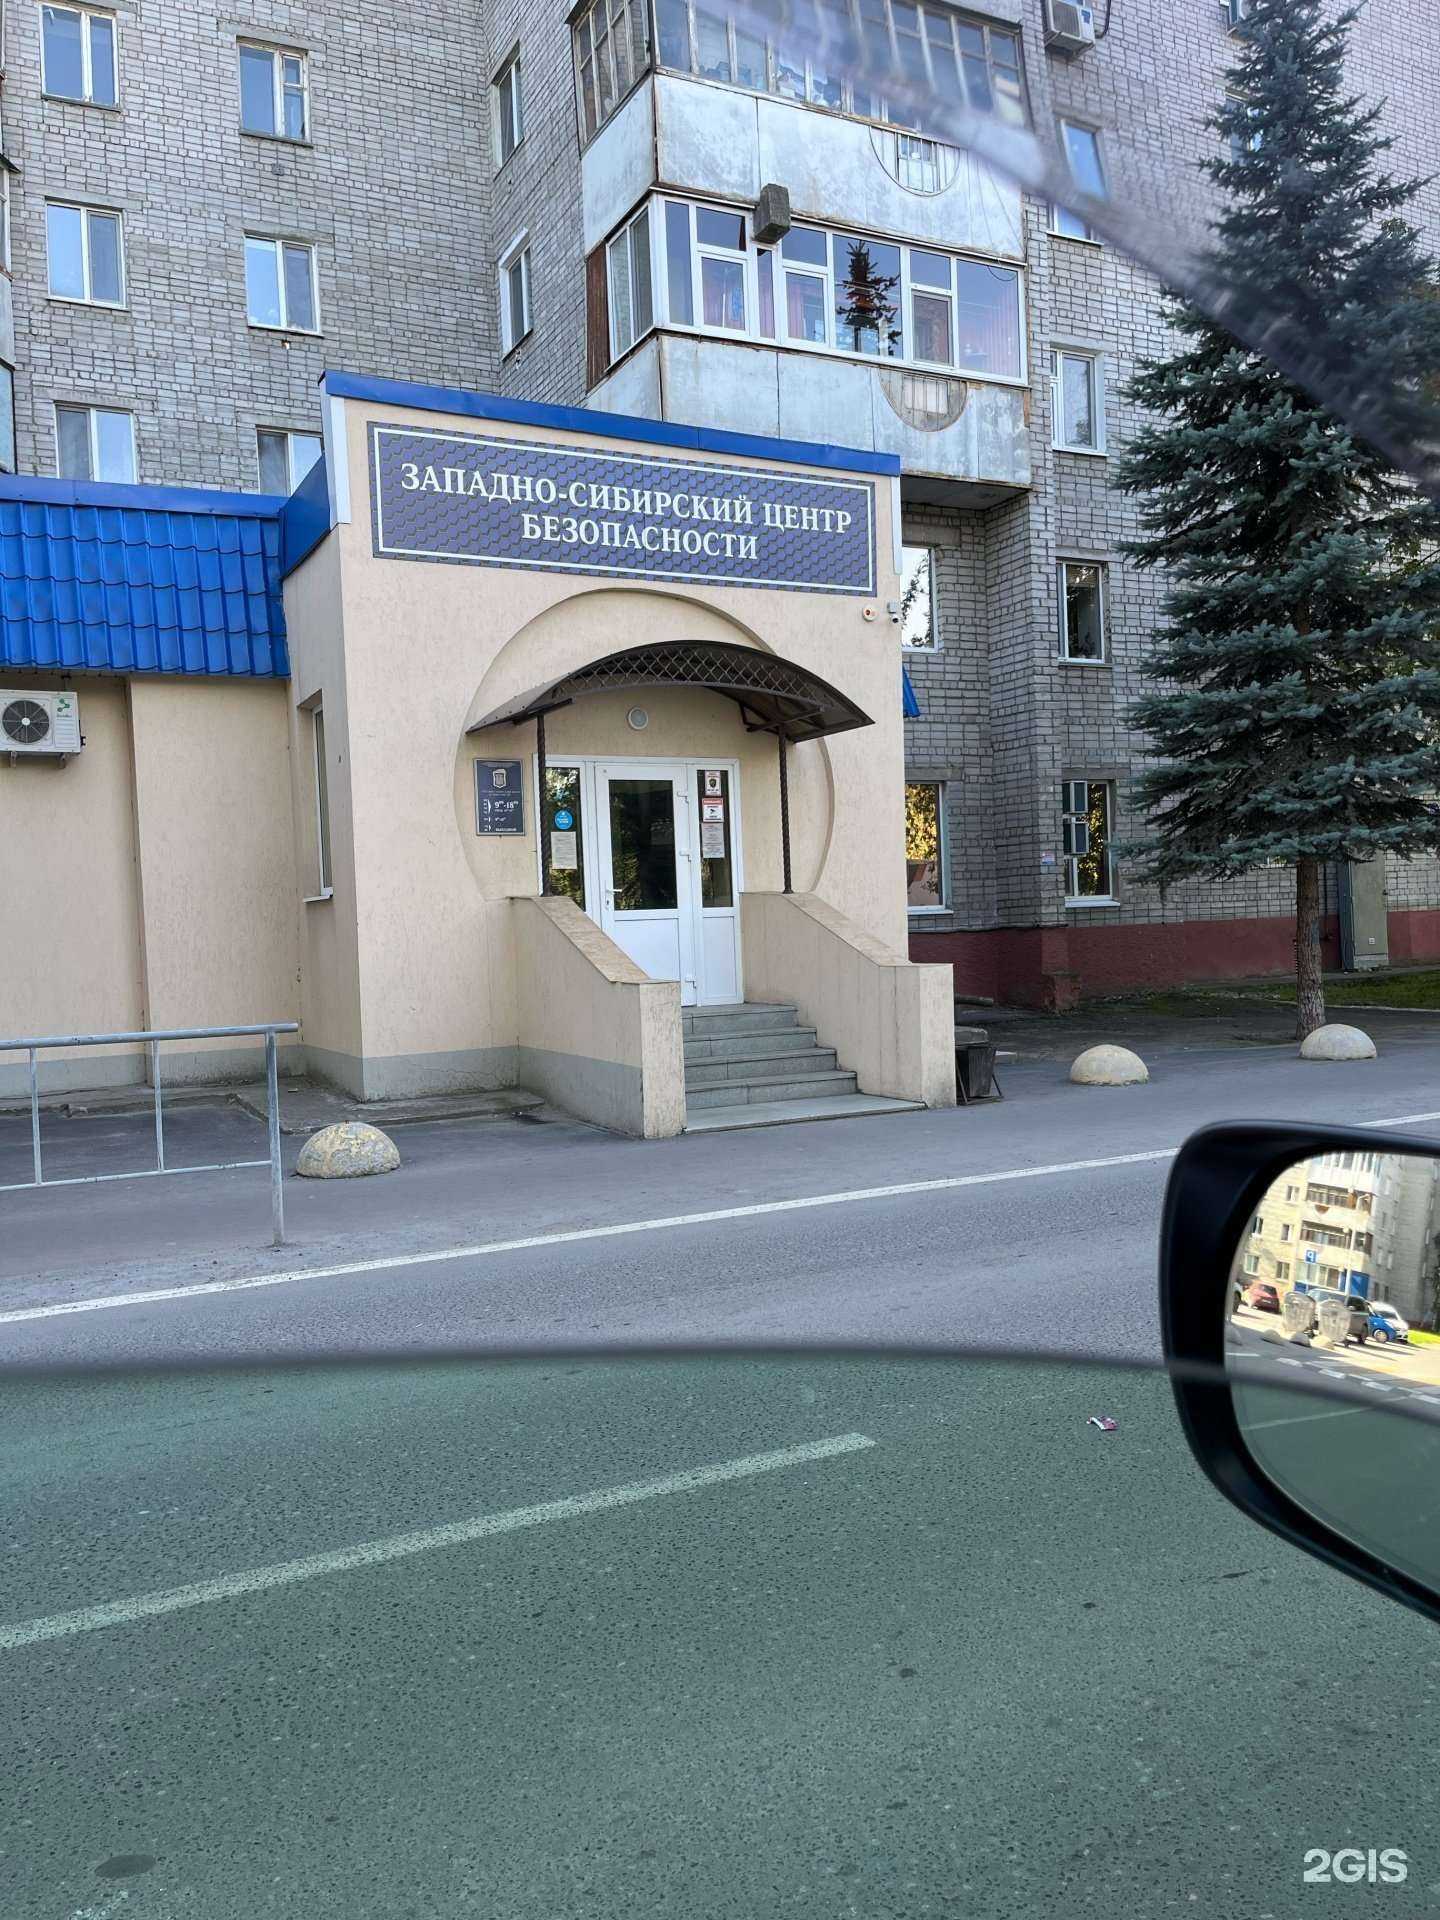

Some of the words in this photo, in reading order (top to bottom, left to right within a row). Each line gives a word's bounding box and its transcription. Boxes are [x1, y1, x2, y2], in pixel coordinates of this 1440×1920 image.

[401, 463, 753, 524] ЗАПАДНО-СИБИРСКИЙ
[762, 503, 852, 533] ЦЕНТР
[521, 513, 758, 559] БЕЗОПАСНОСТИ
